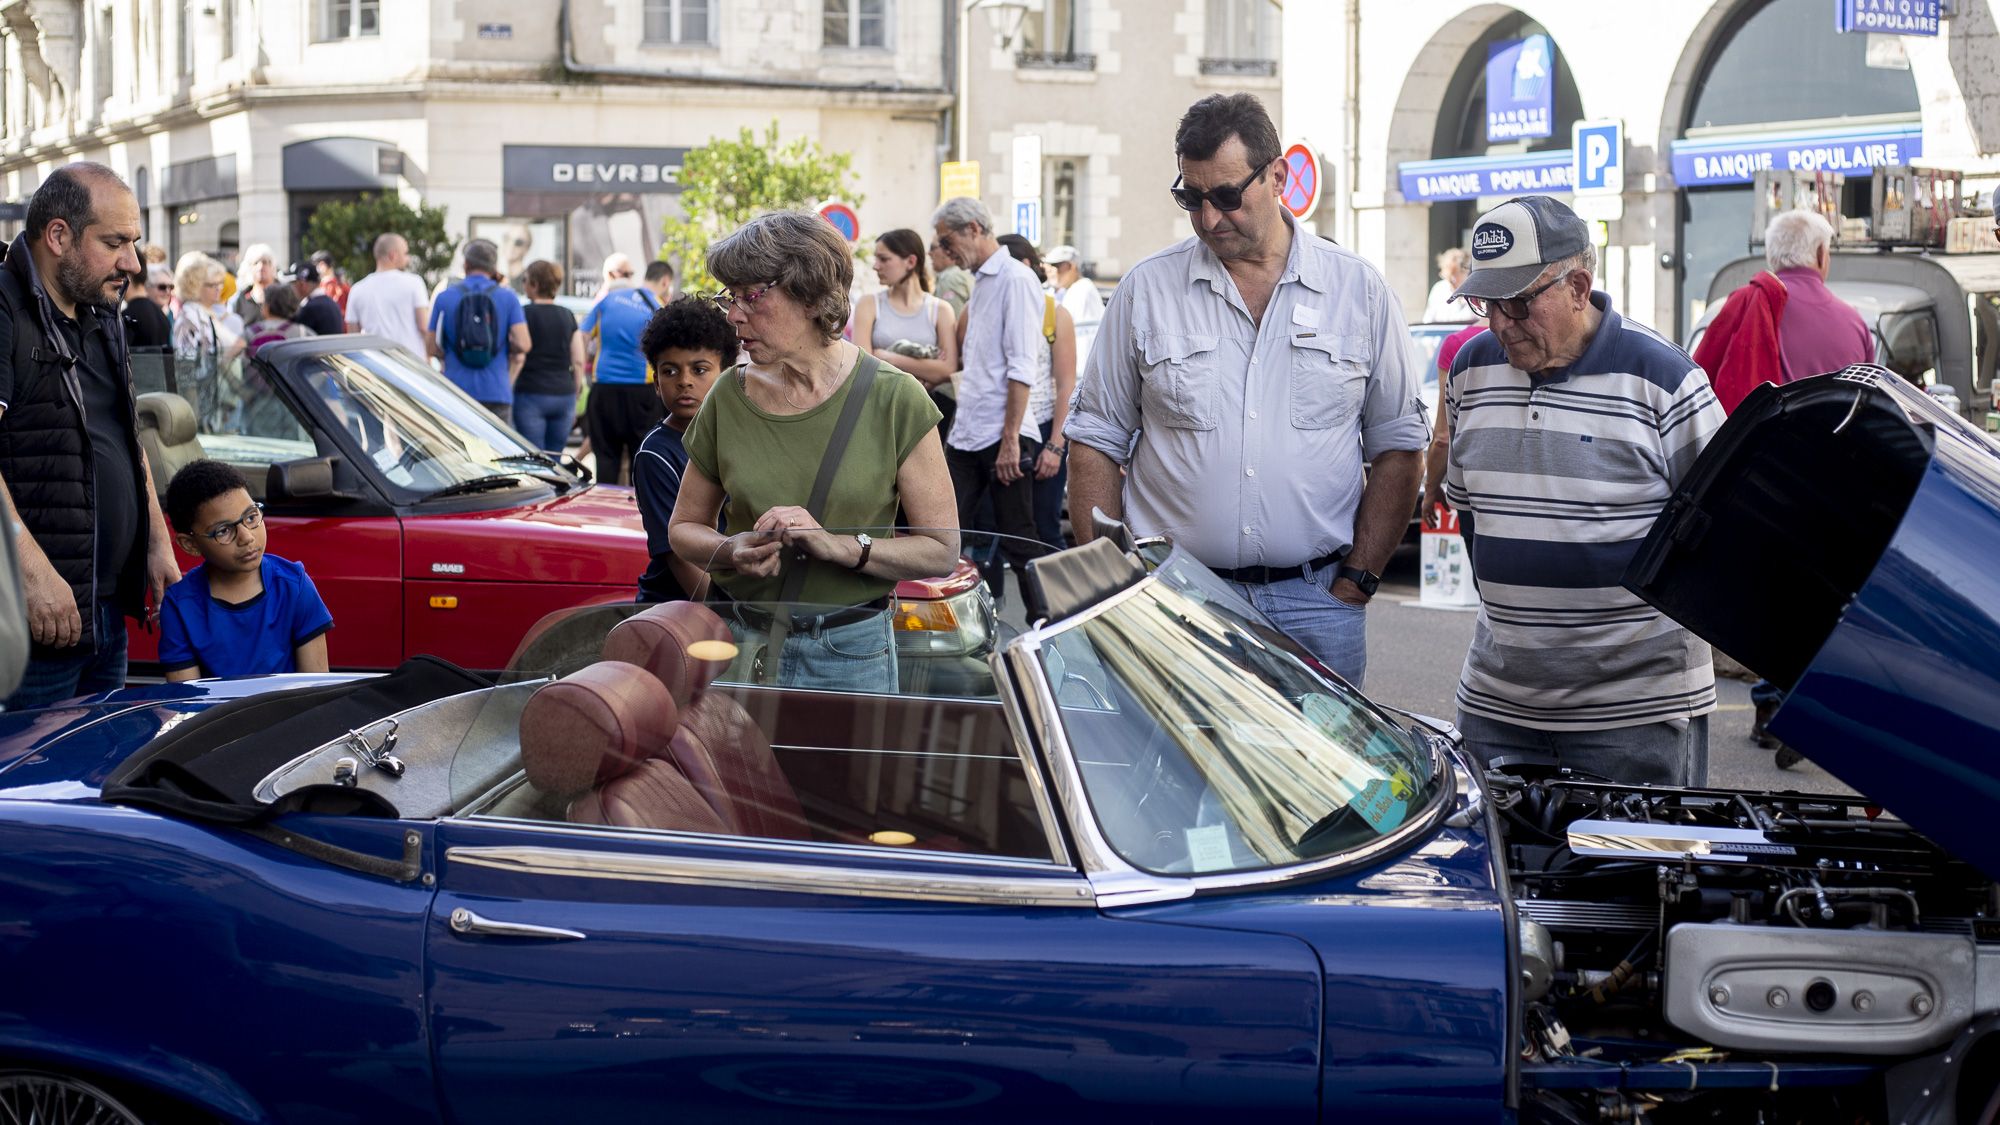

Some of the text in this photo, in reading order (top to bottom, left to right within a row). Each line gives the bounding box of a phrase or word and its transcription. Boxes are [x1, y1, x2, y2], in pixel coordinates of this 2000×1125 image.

[1856, 0, 1936, 17] BANQUE
[1856, 12, 1937, 32] POPULAIRE
[1489, 107, 1547, 124] BANQUE
[1489, 120, 1548, 137] POPULAIRE
[1586, 134, 1609, 181] P
[1694, 143, 1899, 179] BANQUE POPULAIRE
[1417, 173, 1481, 196] BANQUE
[1482, 229, 1509, 246] Dutch
[432, 563, 464, 573] SAAB
[1354, 801, 1367, 811] Le
[1369, 796, 1393, 824] de Blois
